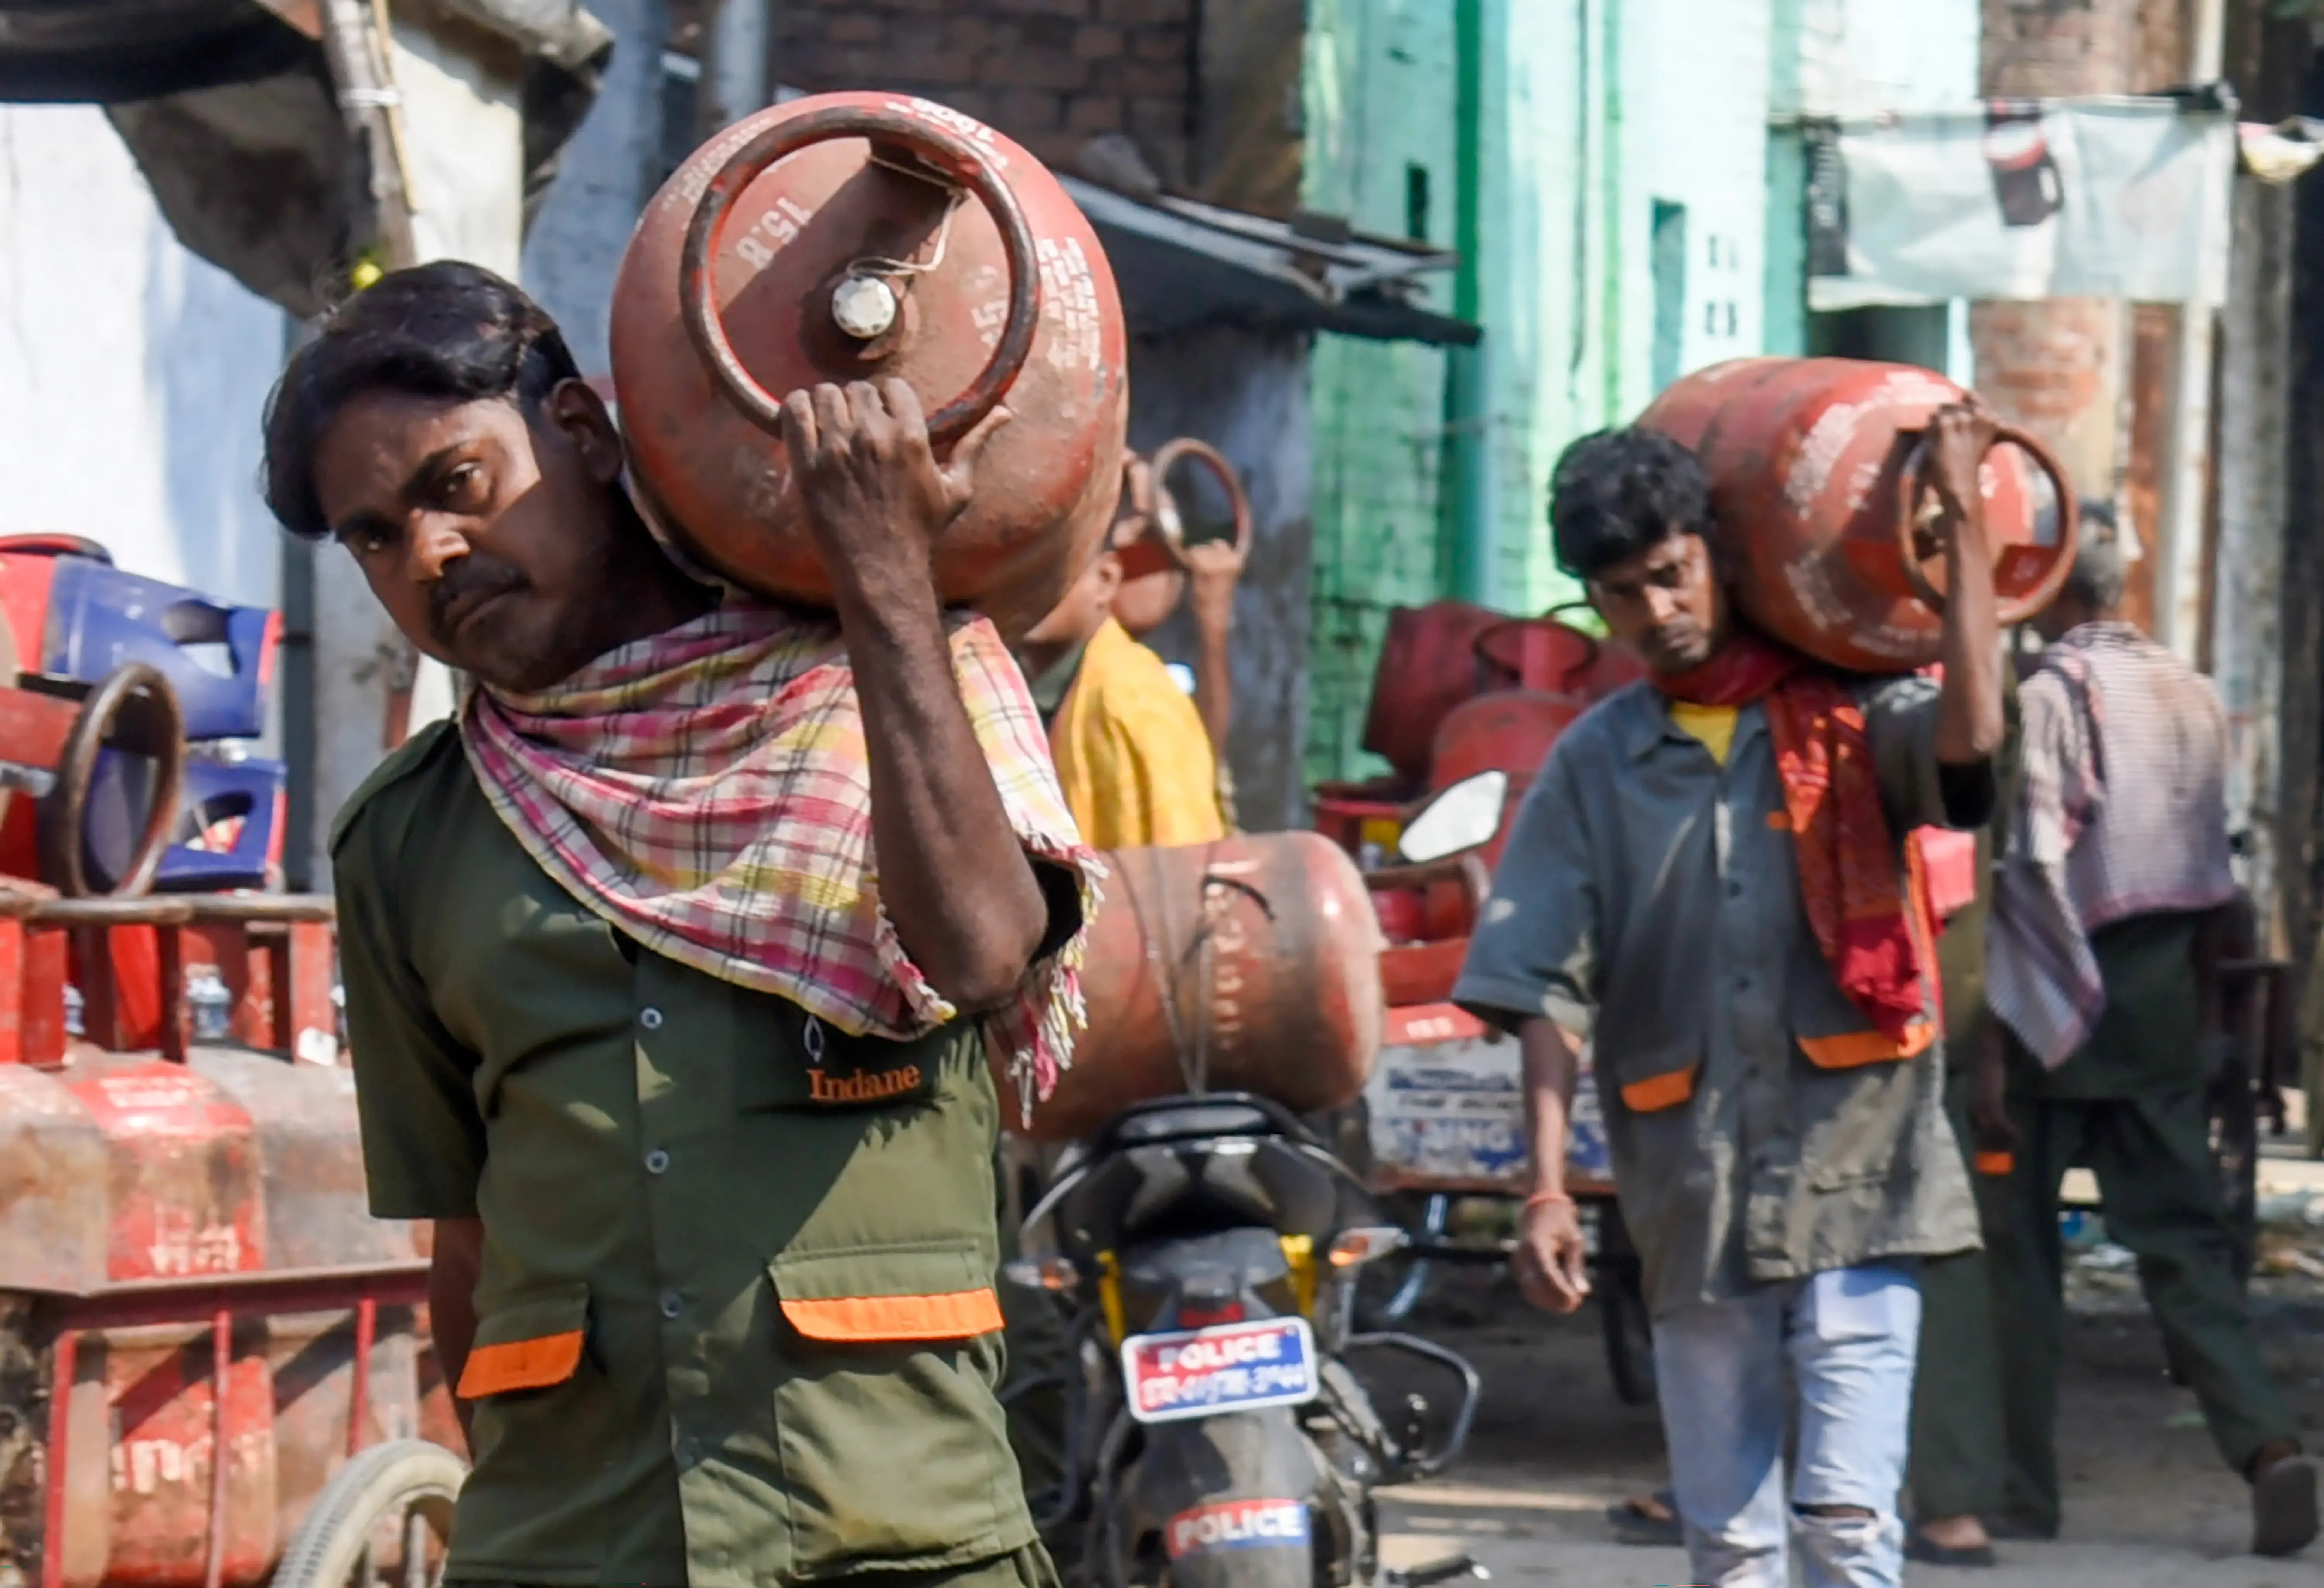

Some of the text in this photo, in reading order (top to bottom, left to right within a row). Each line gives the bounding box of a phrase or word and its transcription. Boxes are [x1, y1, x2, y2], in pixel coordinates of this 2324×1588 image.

[806, 1064, 921, 1103] Indane
[1157, 1333, 1282, 1373] POLICE
[1175, 1506, 1304, 1548] POLICE
